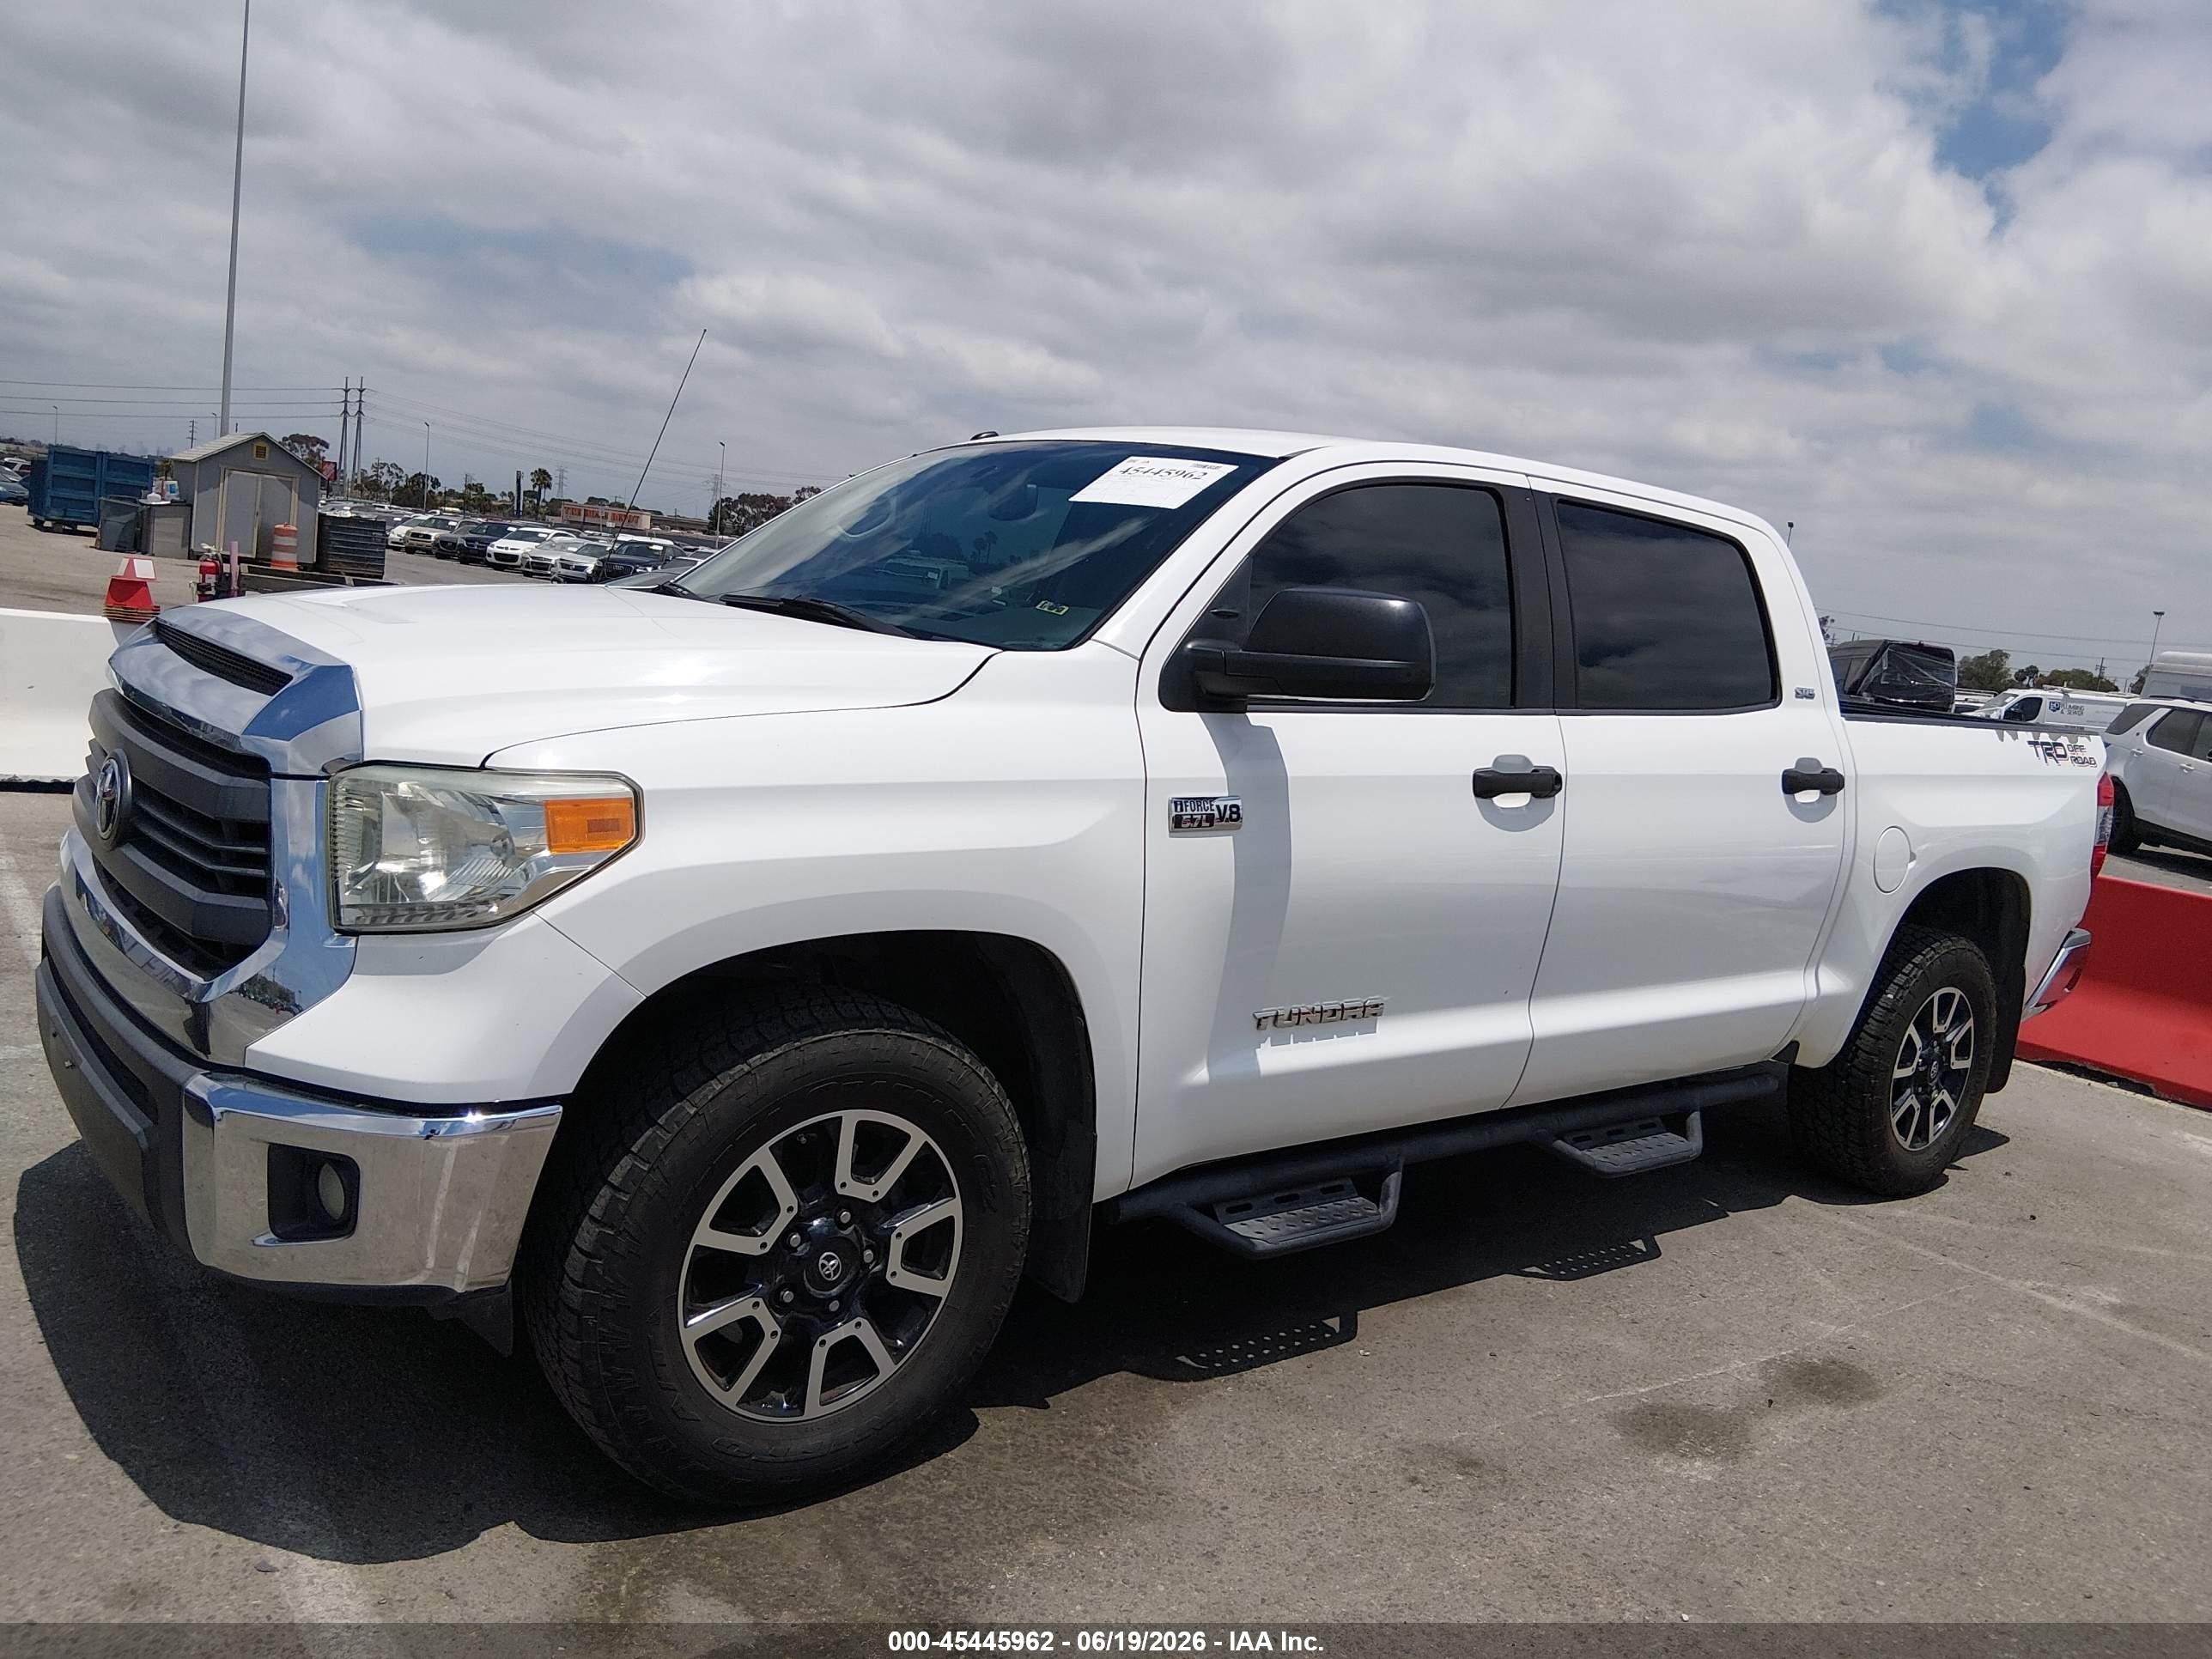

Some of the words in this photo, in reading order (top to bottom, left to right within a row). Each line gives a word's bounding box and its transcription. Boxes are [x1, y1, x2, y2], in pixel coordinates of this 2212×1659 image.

[1119, 466, 1208, 480] 45445962
[2027, 741, 2068, 764] TRD
[2070, 756, 2097, 767] ROAD
[1216, 804, 1241, 823] V8
[1253, 996, 1384, 1030] TUNDRA
